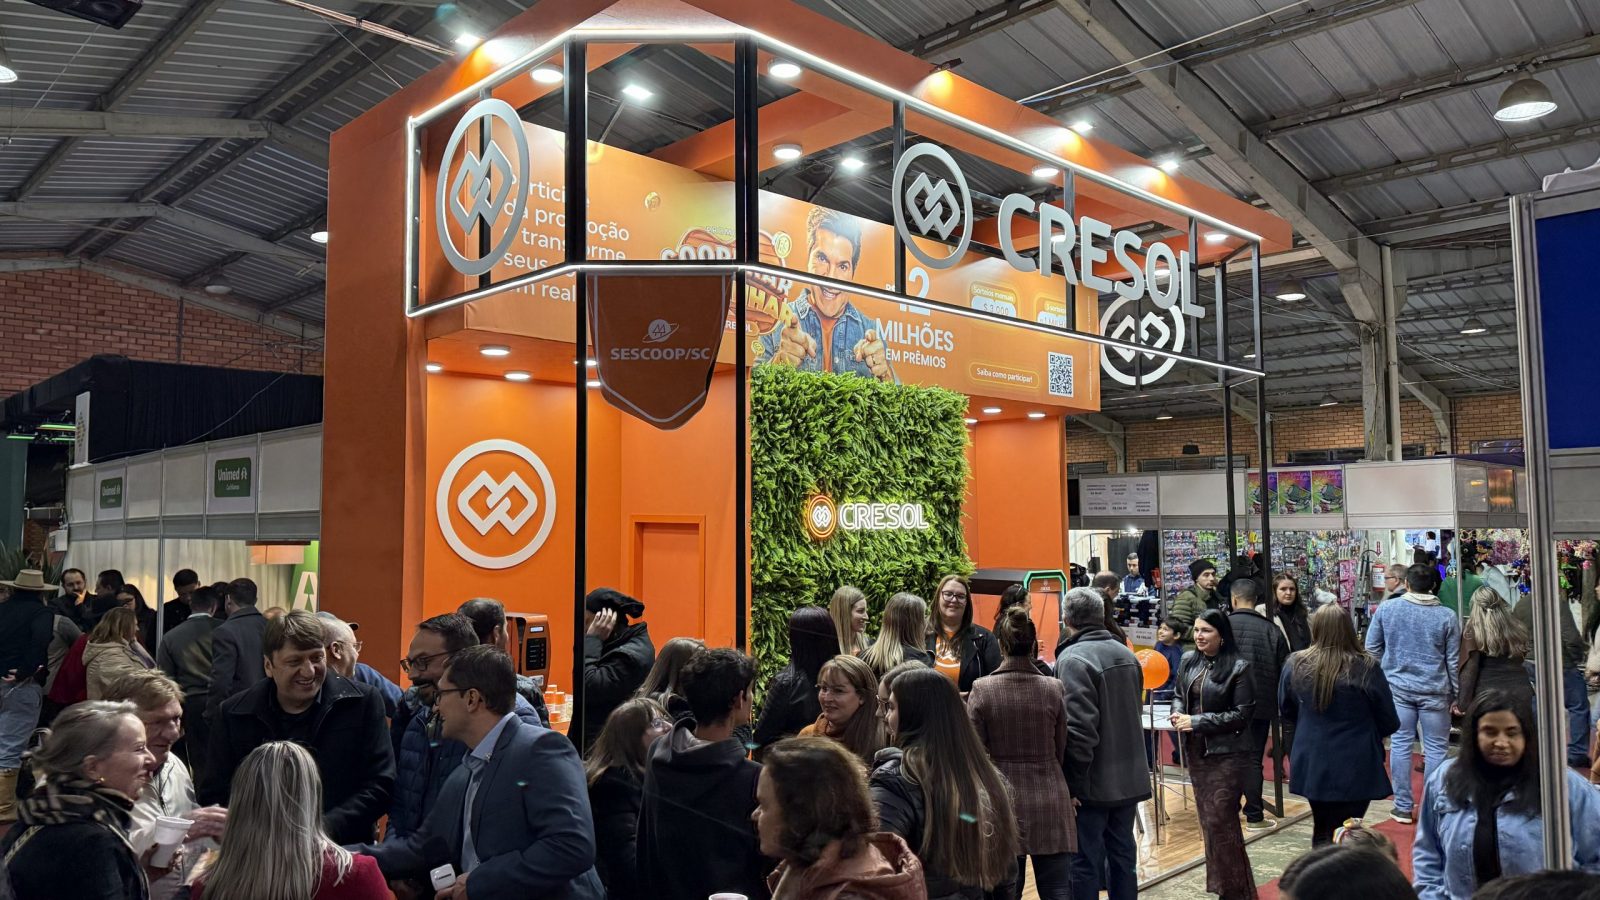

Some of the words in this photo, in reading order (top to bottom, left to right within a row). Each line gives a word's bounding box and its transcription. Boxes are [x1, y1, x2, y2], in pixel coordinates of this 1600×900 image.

[535, 208, 630, 241] prooção
[522, 228, 626, 260] tranrme
[998, 193, 1206, 319] CRESOL
[504, 252, 548, 270] seus
[542, 284, 577, 302] real
[900, 267, 931, 316] 2
[875, 318, 954, 352] MILHÕES
[610, 347, 711, 360] SESCOOP/SC
[885, 348, 901, 361] EM
[903, 350, 946, 369] PRÊMIOS
[976, 367, 992, 377] Saiba
[992, 371, 1007, 379] como
[1007, 373, 1033, 384] participar!
[217, 468, 240, 481] Unimed
[840, 503, 930, 530] CRESOL
